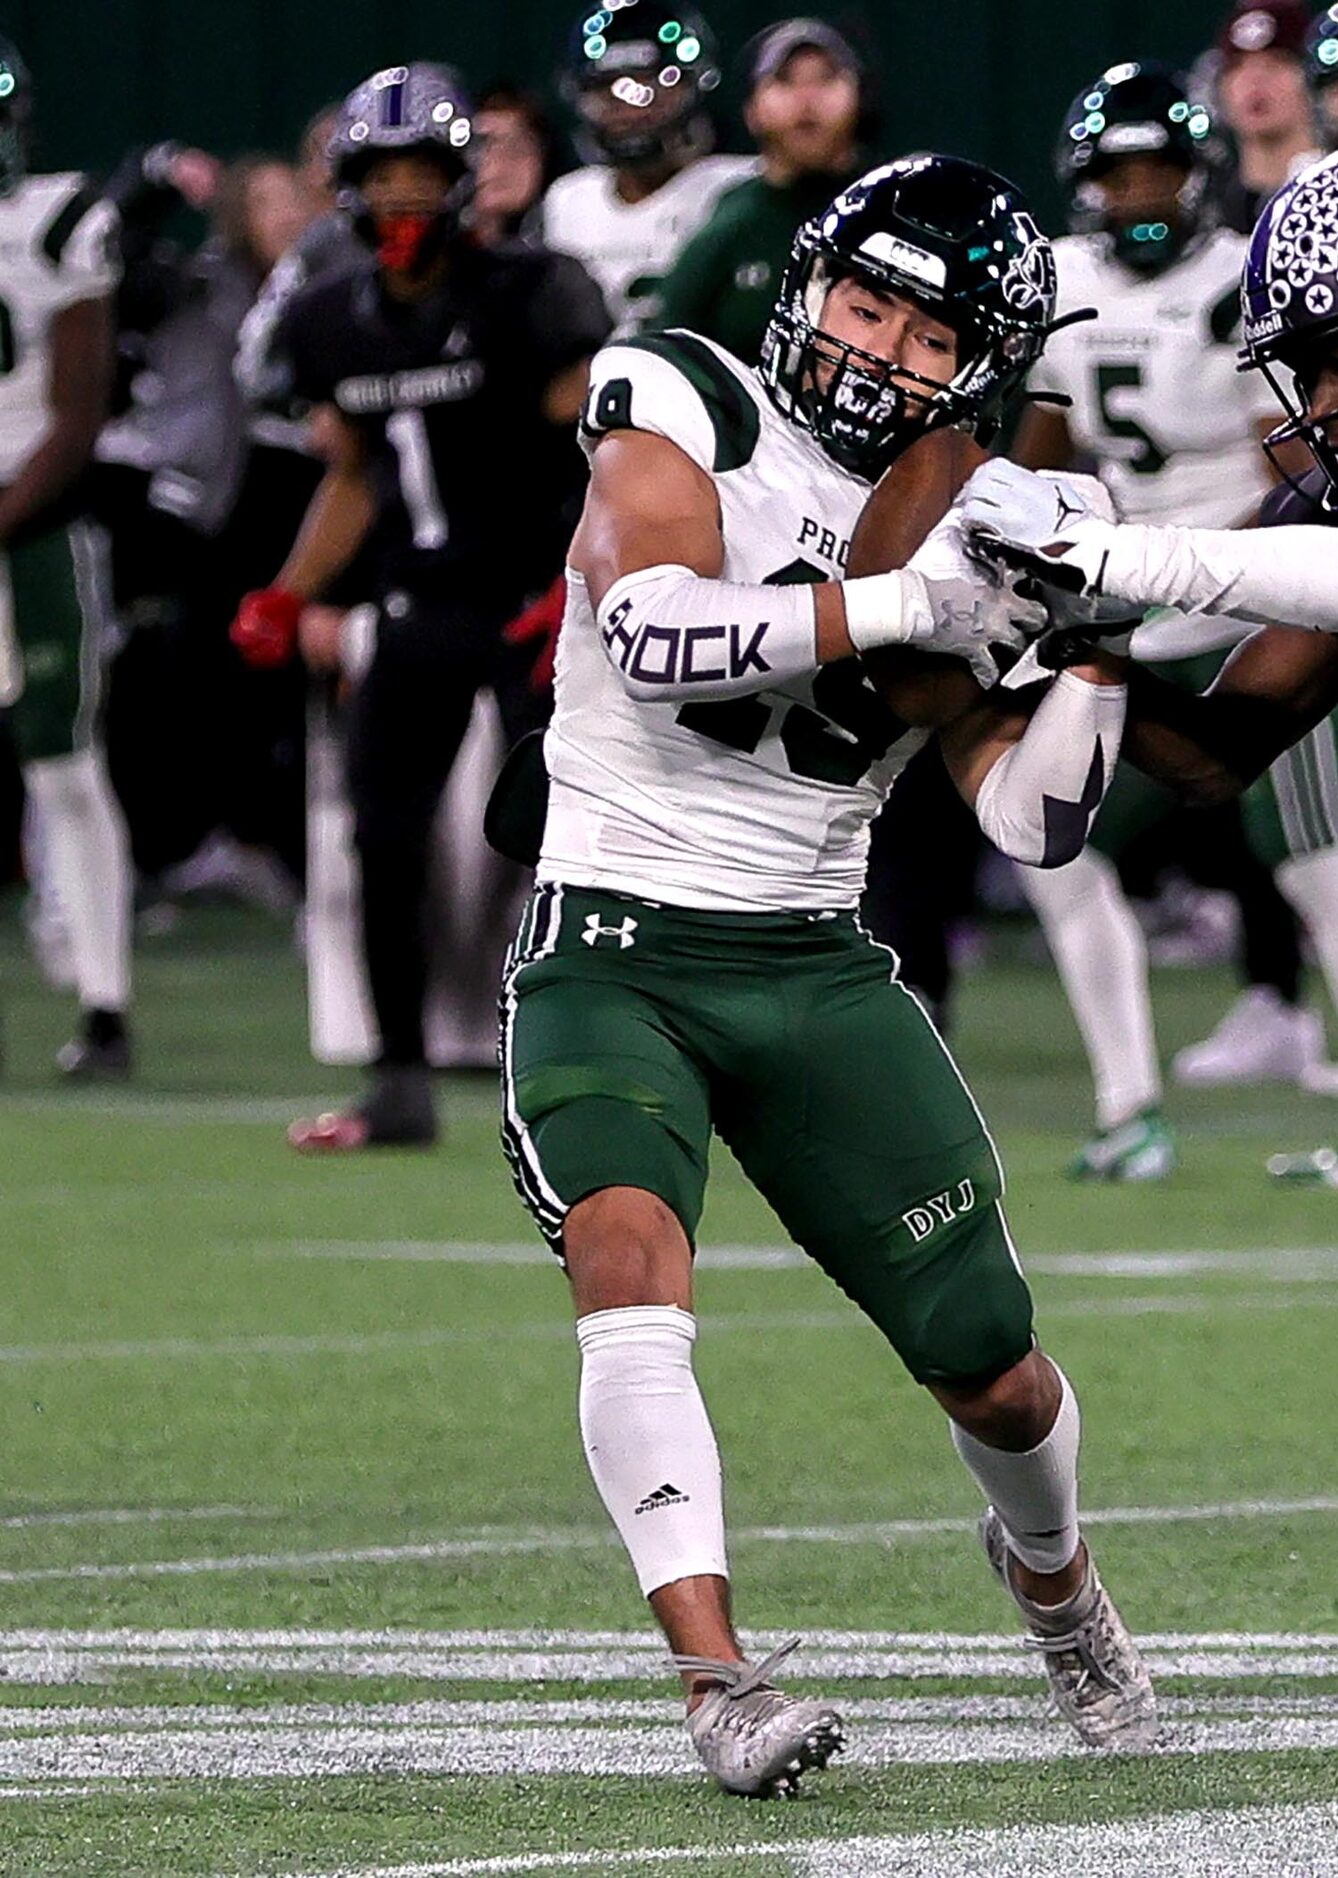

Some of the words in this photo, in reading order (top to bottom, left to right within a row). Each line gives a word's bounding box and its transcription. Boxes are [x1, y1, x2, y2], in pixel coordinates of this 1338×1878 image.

[1095, 363, 1171, 473] 5
[386, 408, 450, 549] 1
[902, 1178, 975, 1242] DYJ
[635, 1494, 690, 1515] adidas
